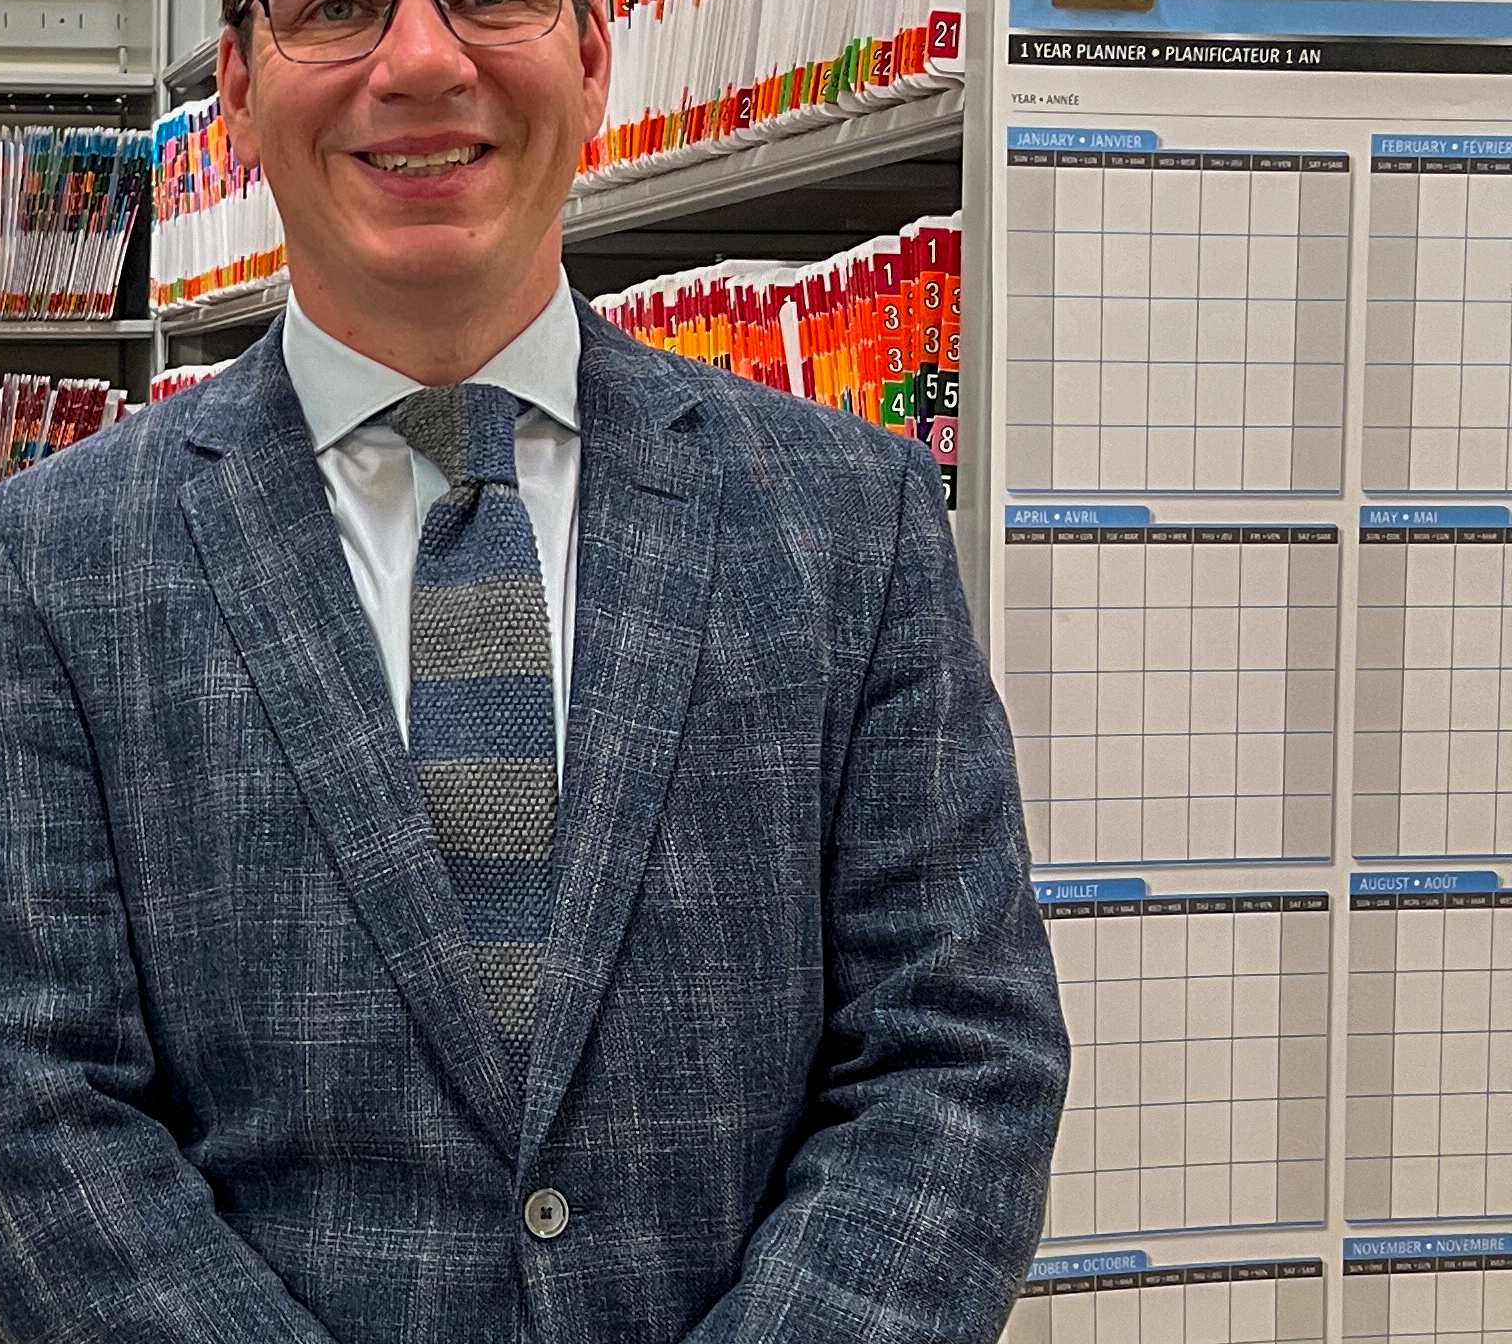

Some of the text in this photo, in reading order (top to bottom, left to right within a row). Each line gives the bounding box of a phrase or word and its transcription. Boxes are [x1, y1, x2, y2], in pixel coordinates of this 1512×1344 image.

[934, 20, 958, 48] 21
[1020, 42, 1321, 64] 1 YEAR PLANNER PLANIFICATEUR 1 AN
[1011, 93, 1080, 106] YEAR ANNÉE
[1017, 133, 1142, 148] JANUARY JANVIER
[1381, 139, 1447, 153] FEBRUARY
[1014, 510, 1100, 524] APRIL AVRIL
[1369, 511, 1438, 524] MAY MAI
[1360, 874, 1458, 891] AUGUST AOÛT
[1055, 884, 1099, 899] JUILLET
[1353, 1237, 1506, 1255] NOVEMBER NOVEMBRE
[1083, 1255, 1137, 1272] OCTOBRE
